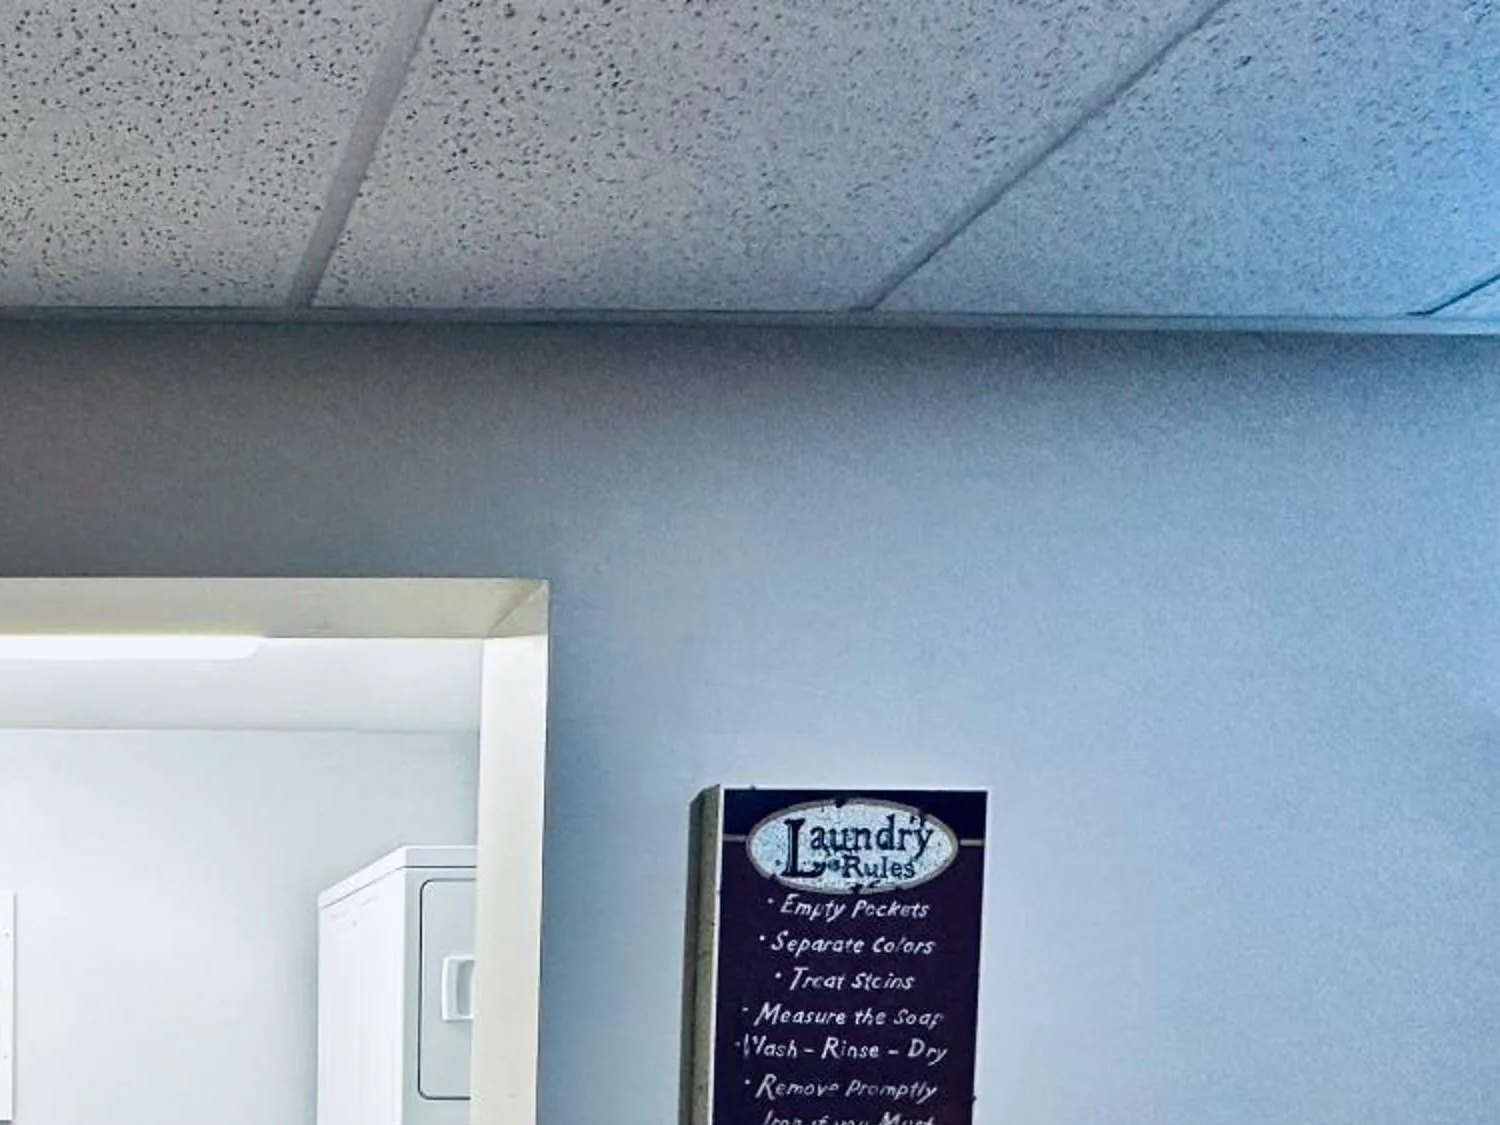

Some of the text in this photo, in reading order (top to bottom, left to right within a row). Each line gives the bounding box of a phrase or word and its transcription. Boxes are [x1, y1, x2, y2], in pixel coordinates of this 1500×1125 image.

[780, 813, 934, 878] Laundry
[842, 854, 916, 879] Rules
[780, 893, 930, 923] Empty Pockets
[771, 930, 936, 958] Separate Colors
[789, 966, 915, 991] Treat Stains
[753, 1001, 944, 1030] Measure the Soap
[743, 1033, 798, 1058] Wash
[821, 1036, 880, 1060] Rinse
[907, 1037, 949, 1066] Dry
[755, 1073, 938, 1104] Remove Promptly
